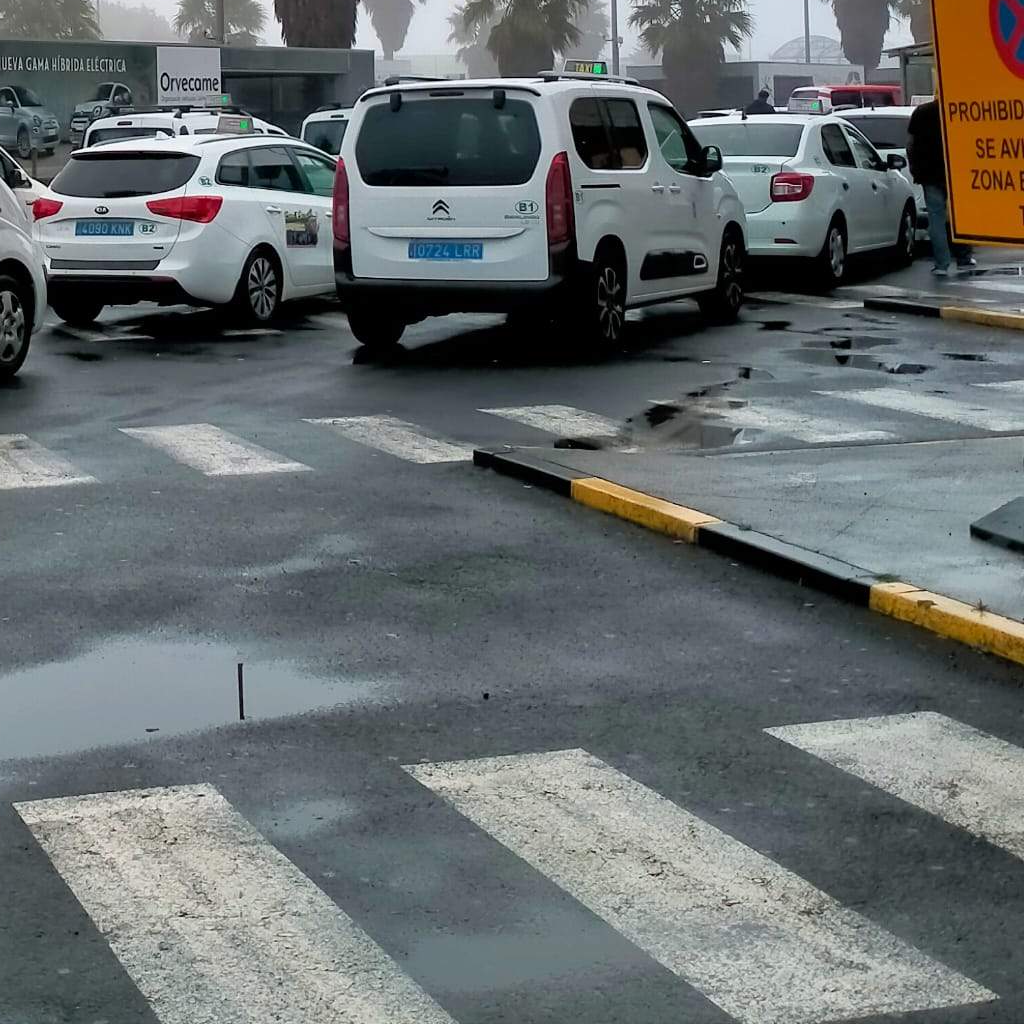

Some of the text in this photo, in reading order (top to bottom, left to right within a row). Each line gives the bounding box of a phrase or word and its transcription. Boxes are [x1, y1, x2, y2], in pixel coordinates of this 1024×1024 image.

[26, 58, 50, 72] GAMA
[52, 55, 84, 73] HÍBRIDA
[86, 56, 127, 73] ELÉCTRICA
[160, 72, 219, 92] Orvecame
[976, 138, 996, 159] SE
[971, 169, 1016, 191] ZONA
[518, 202, 534, 212] B1
[82, 223, 108, 235] 4090
[142, 224, 155, 233] B2
[416, 246, 450, 257] 0724
